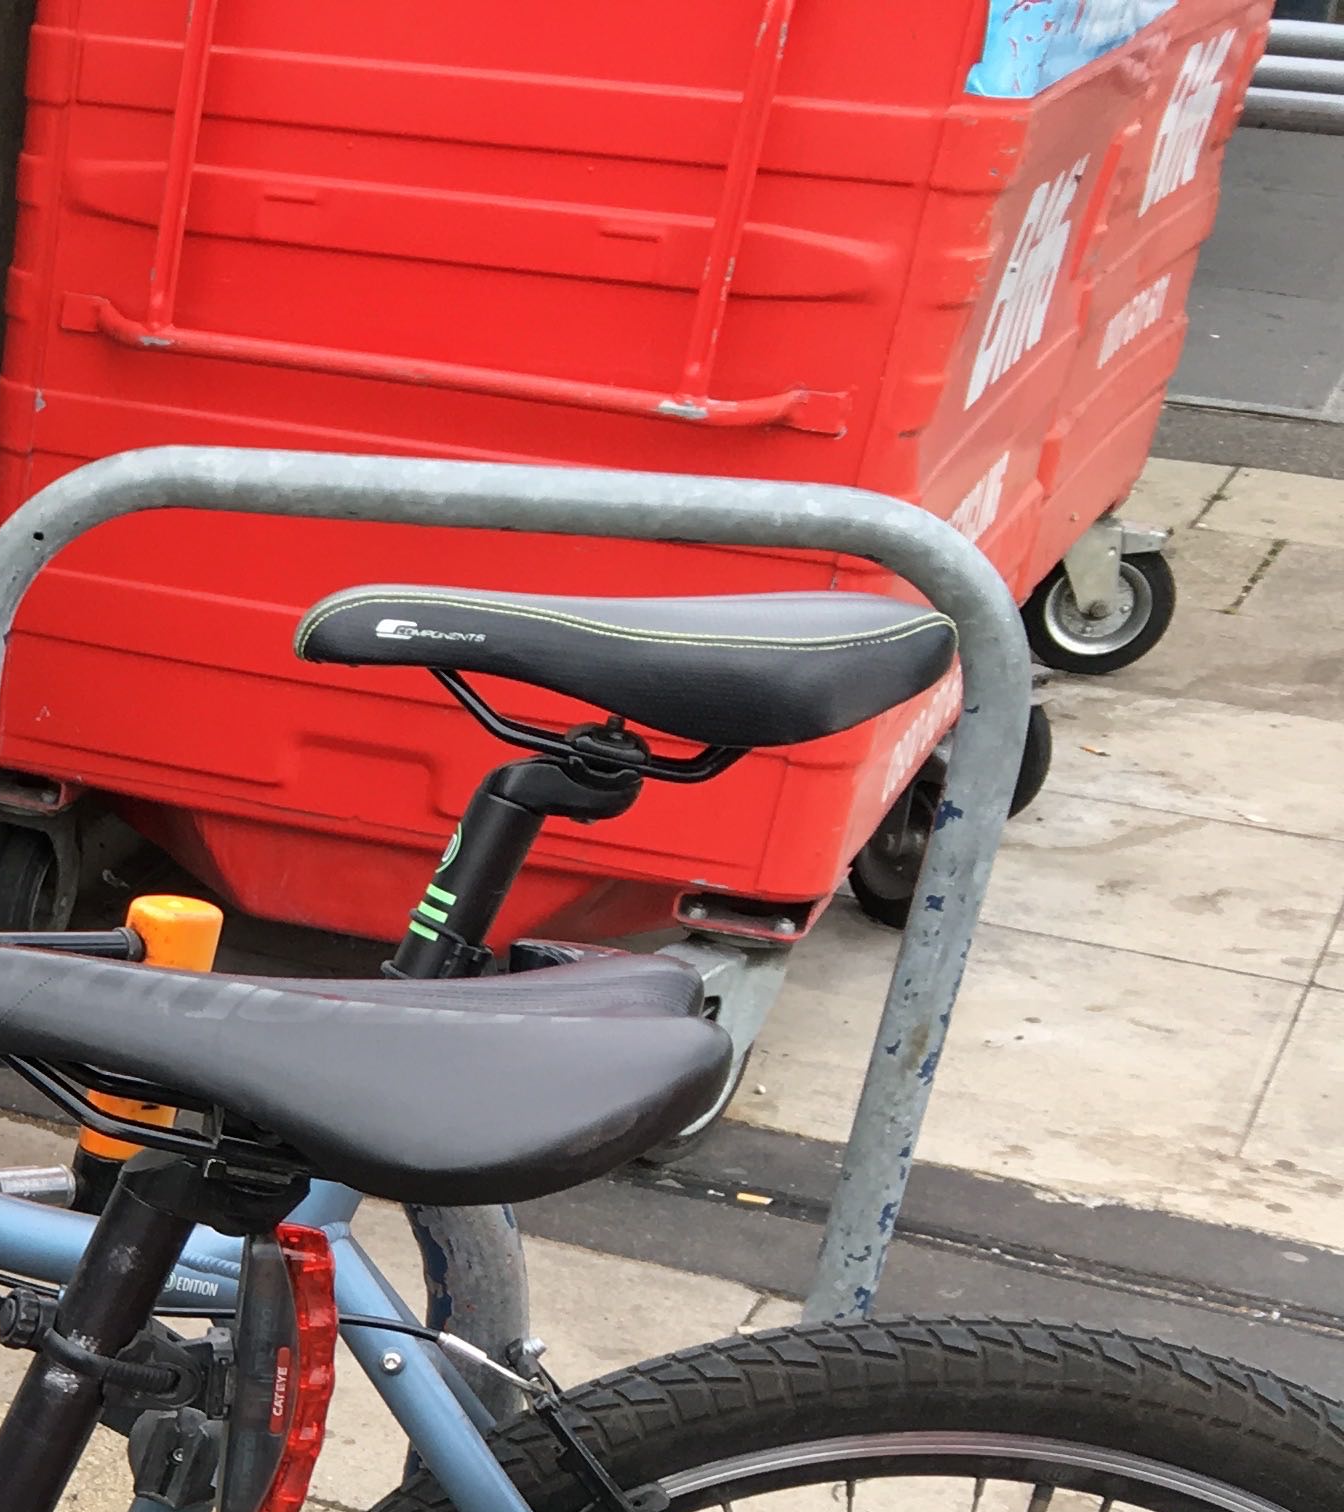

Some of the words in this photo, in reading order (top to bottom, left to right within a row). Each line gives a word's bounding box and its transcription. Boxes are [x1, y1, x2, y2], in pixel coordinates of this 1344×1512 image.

[396, 626, 487, 642] COMPONENTS
[176, 1277, 219, 1297] EDITION
[272, 1366, 288, 1416] CATEYE
